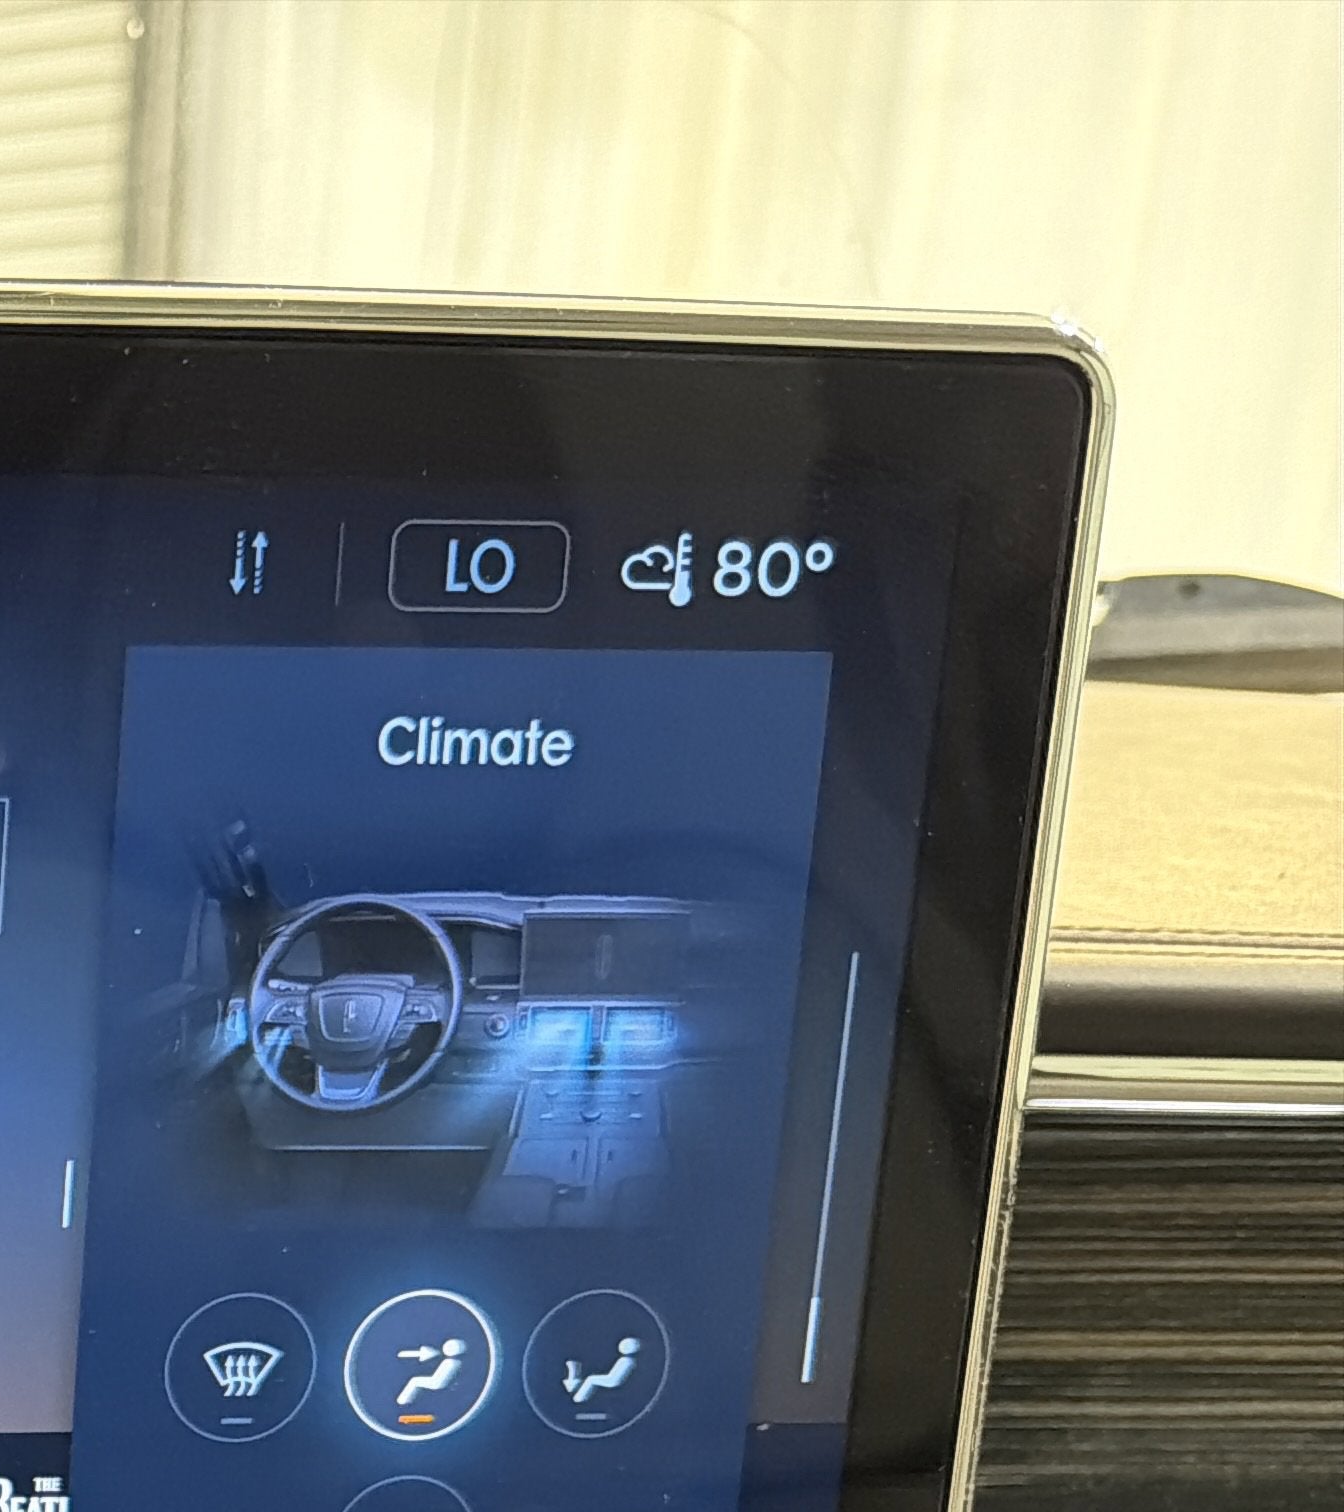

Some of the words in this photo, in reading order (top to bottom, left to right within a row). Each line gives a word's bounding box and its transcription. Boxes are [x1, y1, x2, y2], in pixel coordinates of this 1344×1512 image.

[445, 538, 515, 594] LO
[378, 716, 574, 767] Climate
[32, 1477, 62, 1492] THE
